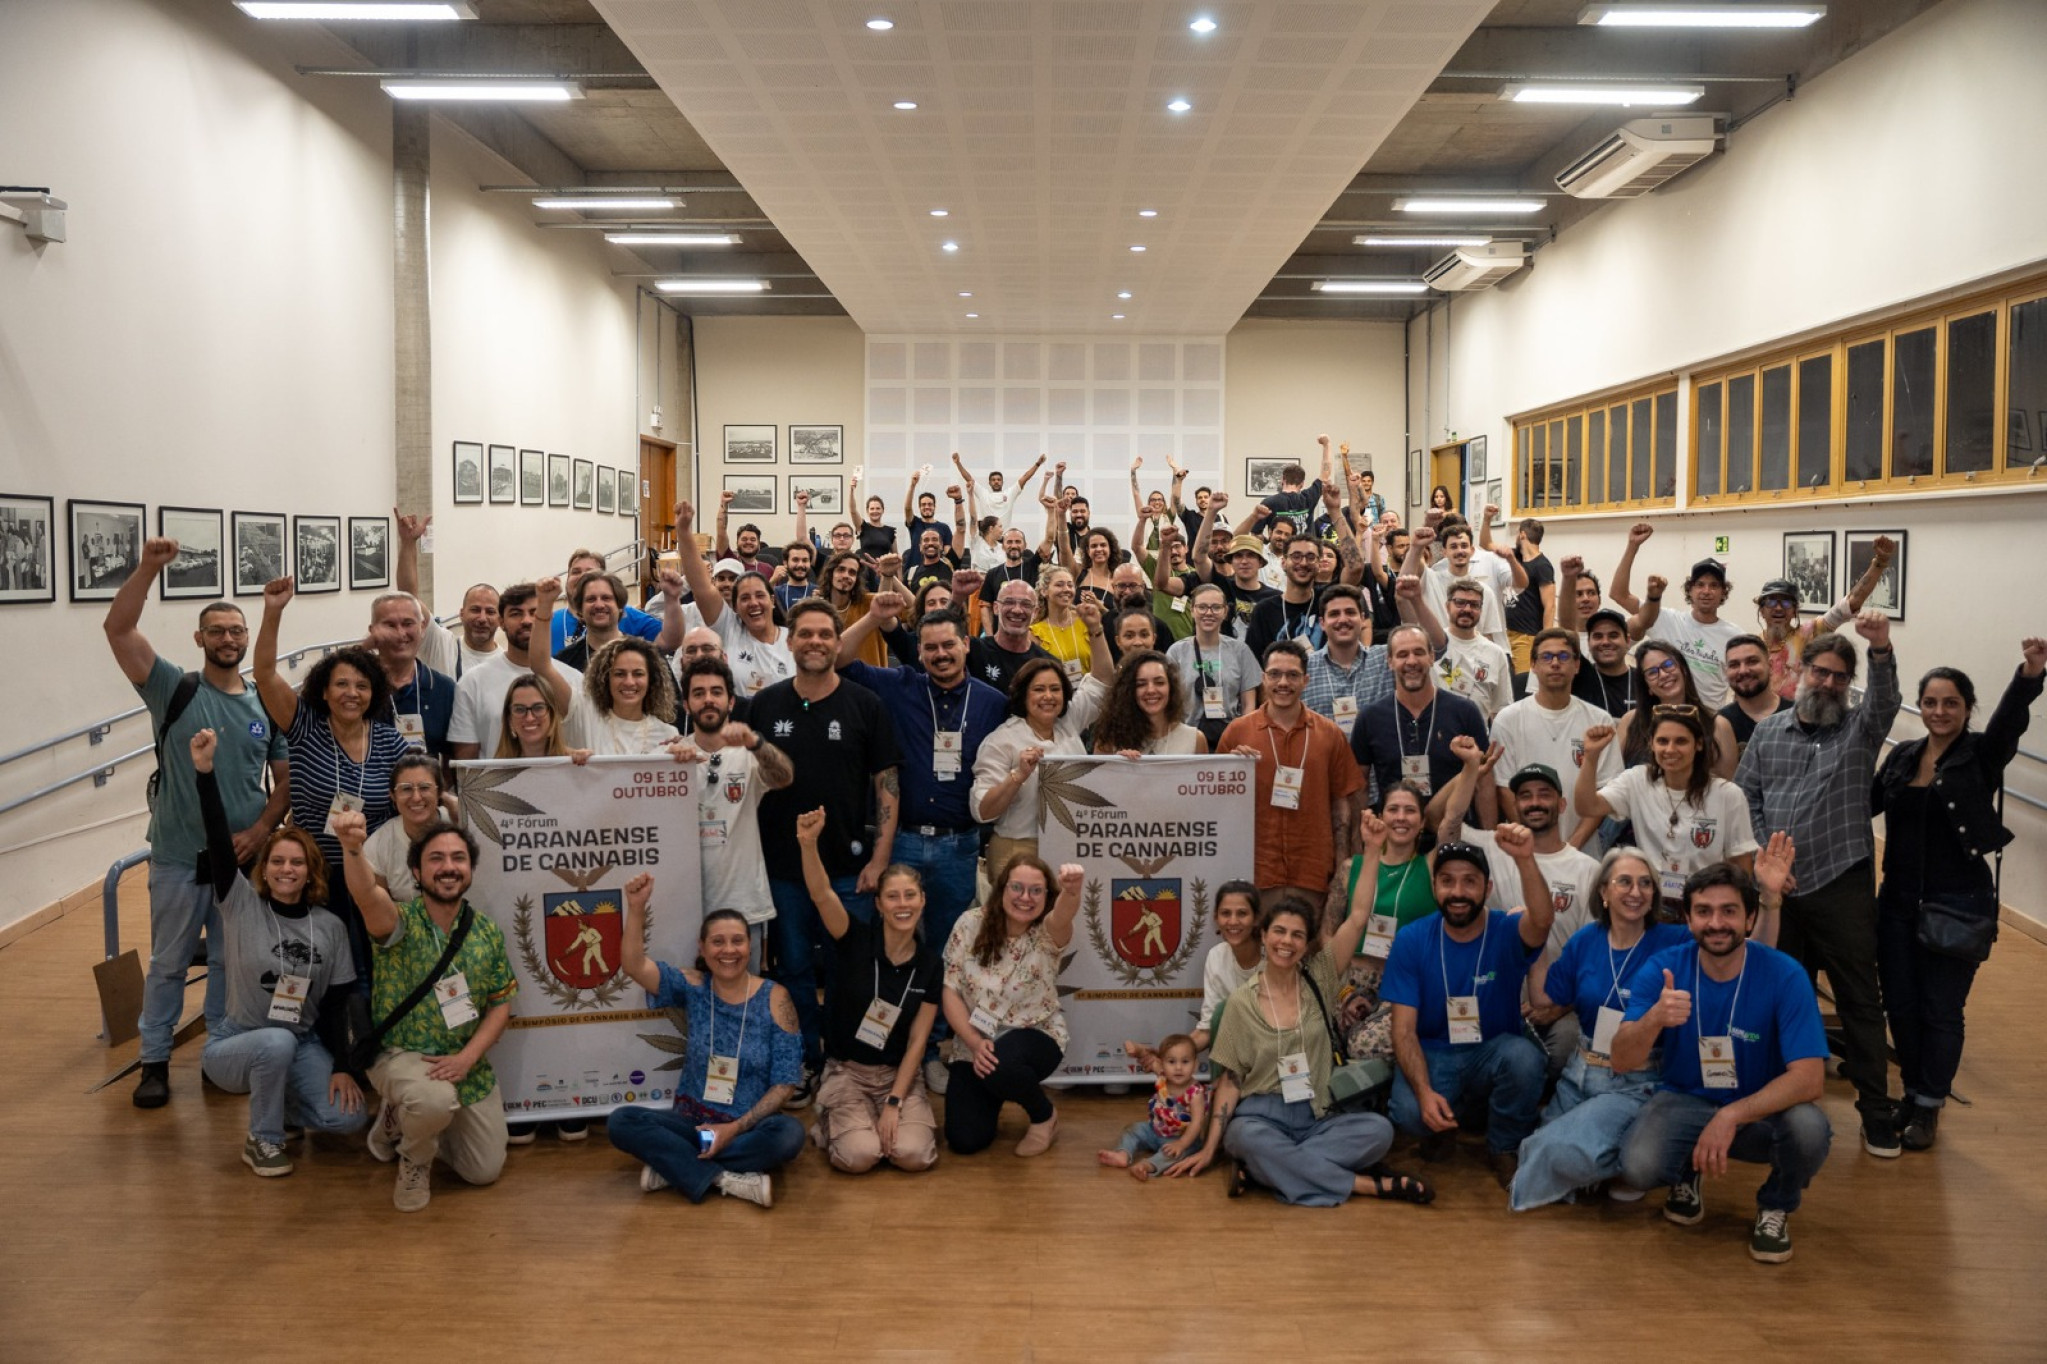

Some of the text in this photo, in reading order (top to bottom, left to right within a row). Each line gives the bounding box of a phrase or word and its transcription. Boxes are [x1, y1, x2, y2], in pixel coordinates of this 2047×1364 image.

[633, 770, 688, 784] 09 E 10
[1197, 770, 1247, 782] 09 E 10
[613, 785, 688, 799] OUTUBRO
[1178, 783, 1247, 796] OUTUBRO
[1091, 809, 1128, 819] Fórum
[517, 816, 558, 828] Fórum
[1076, 821, 1218, 839] PARANAENSE
[502, 826, 659, 850] PARANAENSE
[1076, 841, 1218, 858] DE CANNABIS
[503, 849, 660, 872] DE CANNABIS
[583, 1012, 629, 1023] CANNABIS
